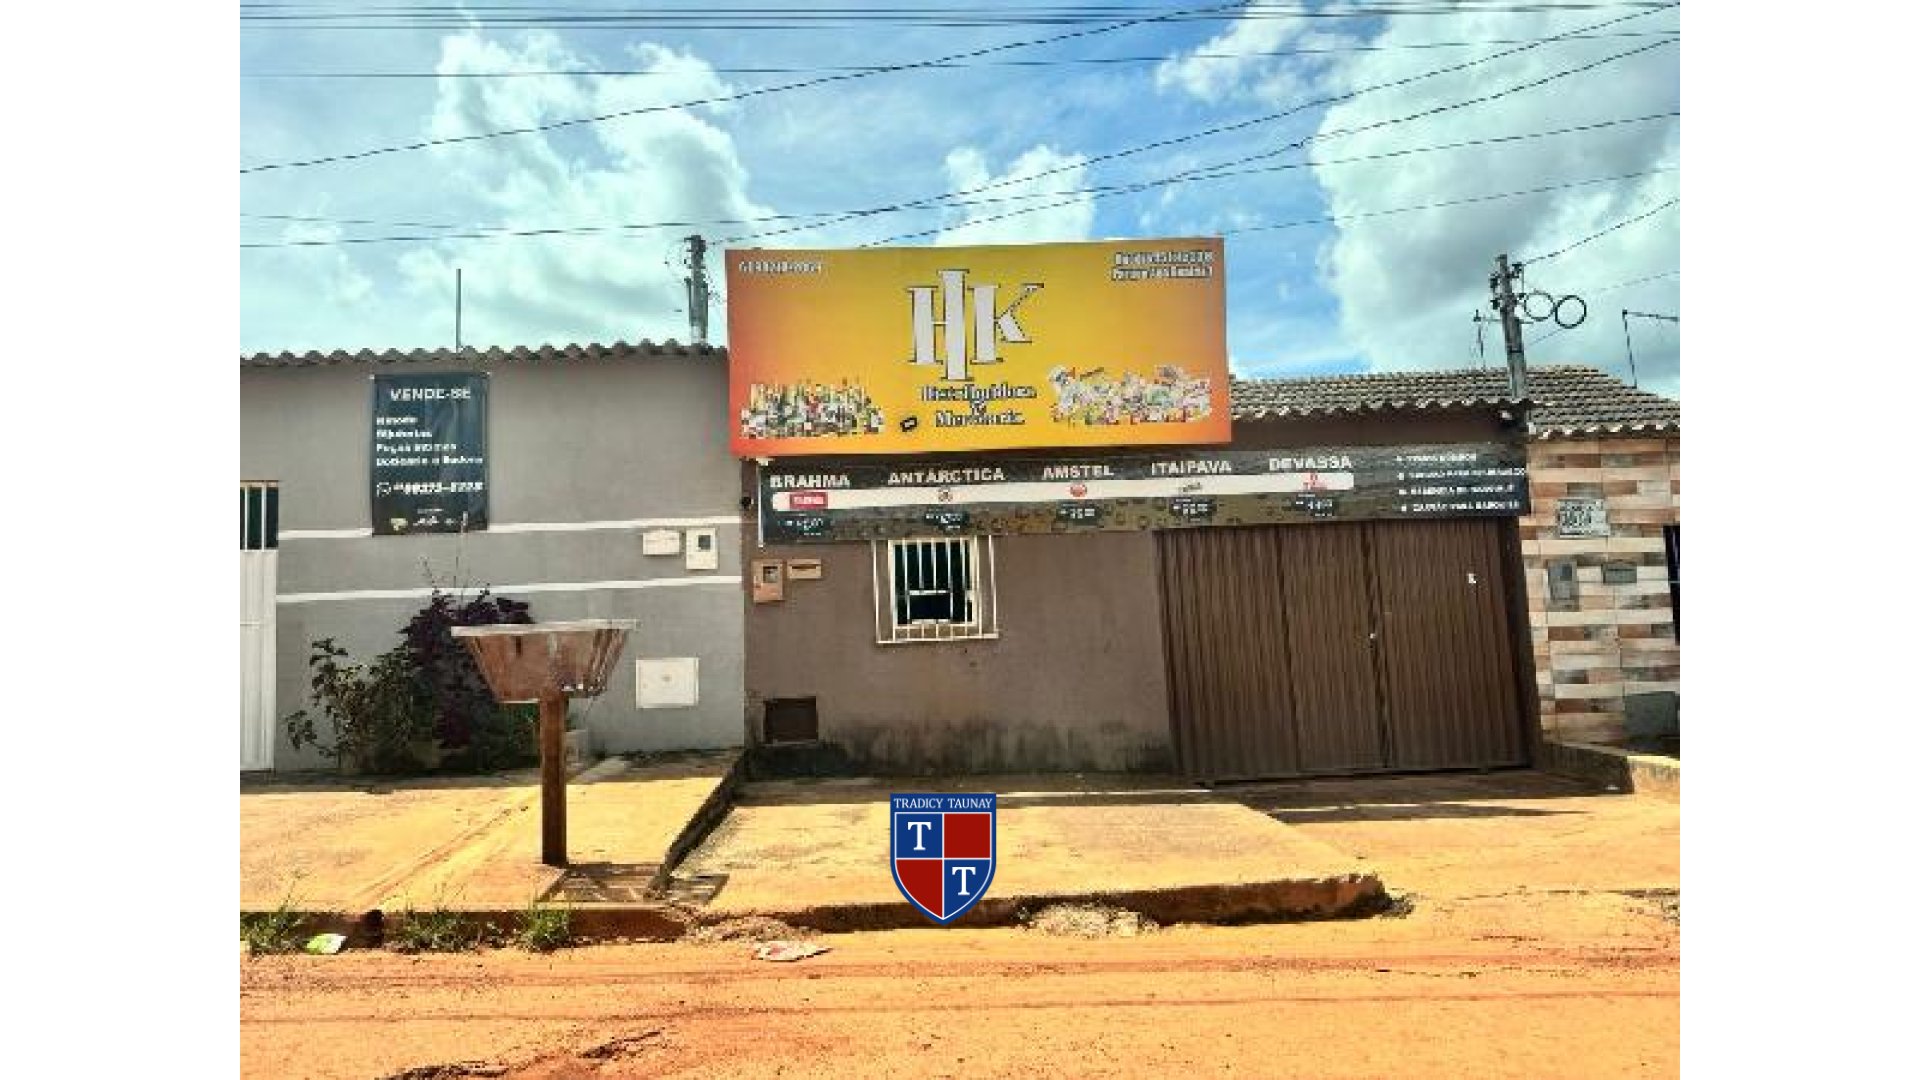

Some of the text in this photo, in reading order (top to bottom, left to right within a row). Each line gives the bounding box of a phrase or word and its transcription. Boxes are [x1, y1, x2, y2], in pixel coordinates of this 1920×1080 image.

[390, 388, 471, 401] VENDE-SE
[769, 474, 851, 488] BRAHMA
[1042, 464, 1115, 480] AMSTEL
[1151, 459, 1232, 475] ITAIPAVA
[1269, 455, 1353, 471] DEVASSA
